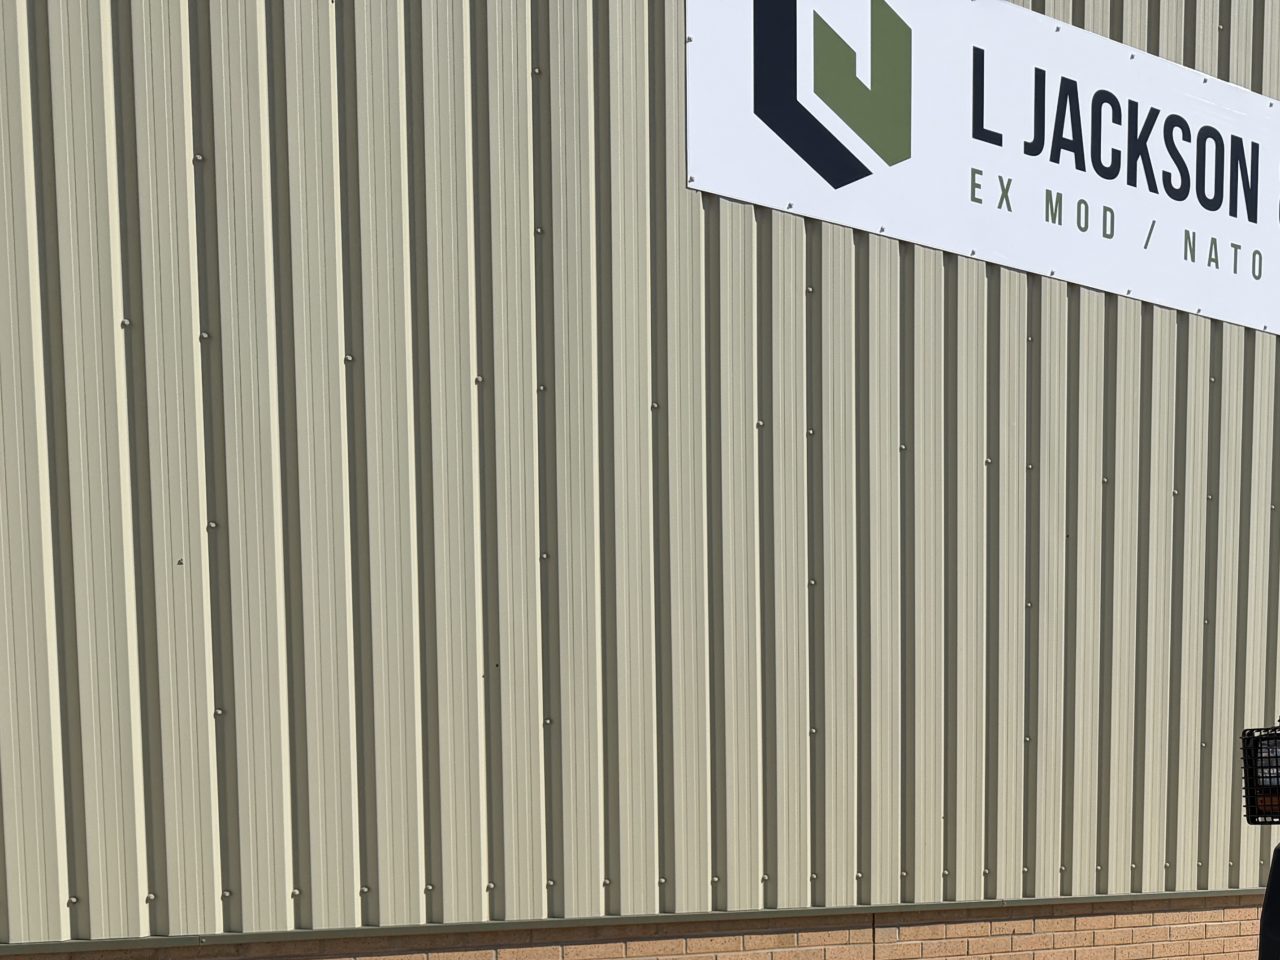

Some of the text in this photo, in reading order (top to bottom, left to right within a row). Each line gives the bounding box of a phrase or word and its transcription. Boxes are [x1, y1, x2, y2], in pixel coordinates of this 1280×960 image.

[971, 45, 1004, 148] L
[1023, 66, 1260, 225] JACKSON
[970, 167, 1014, 213] EX
[1044, 188, 1117, 241] MOD
[1143, 219, 1157, 250] /
[1182, 229, 1264, 282] NATO
